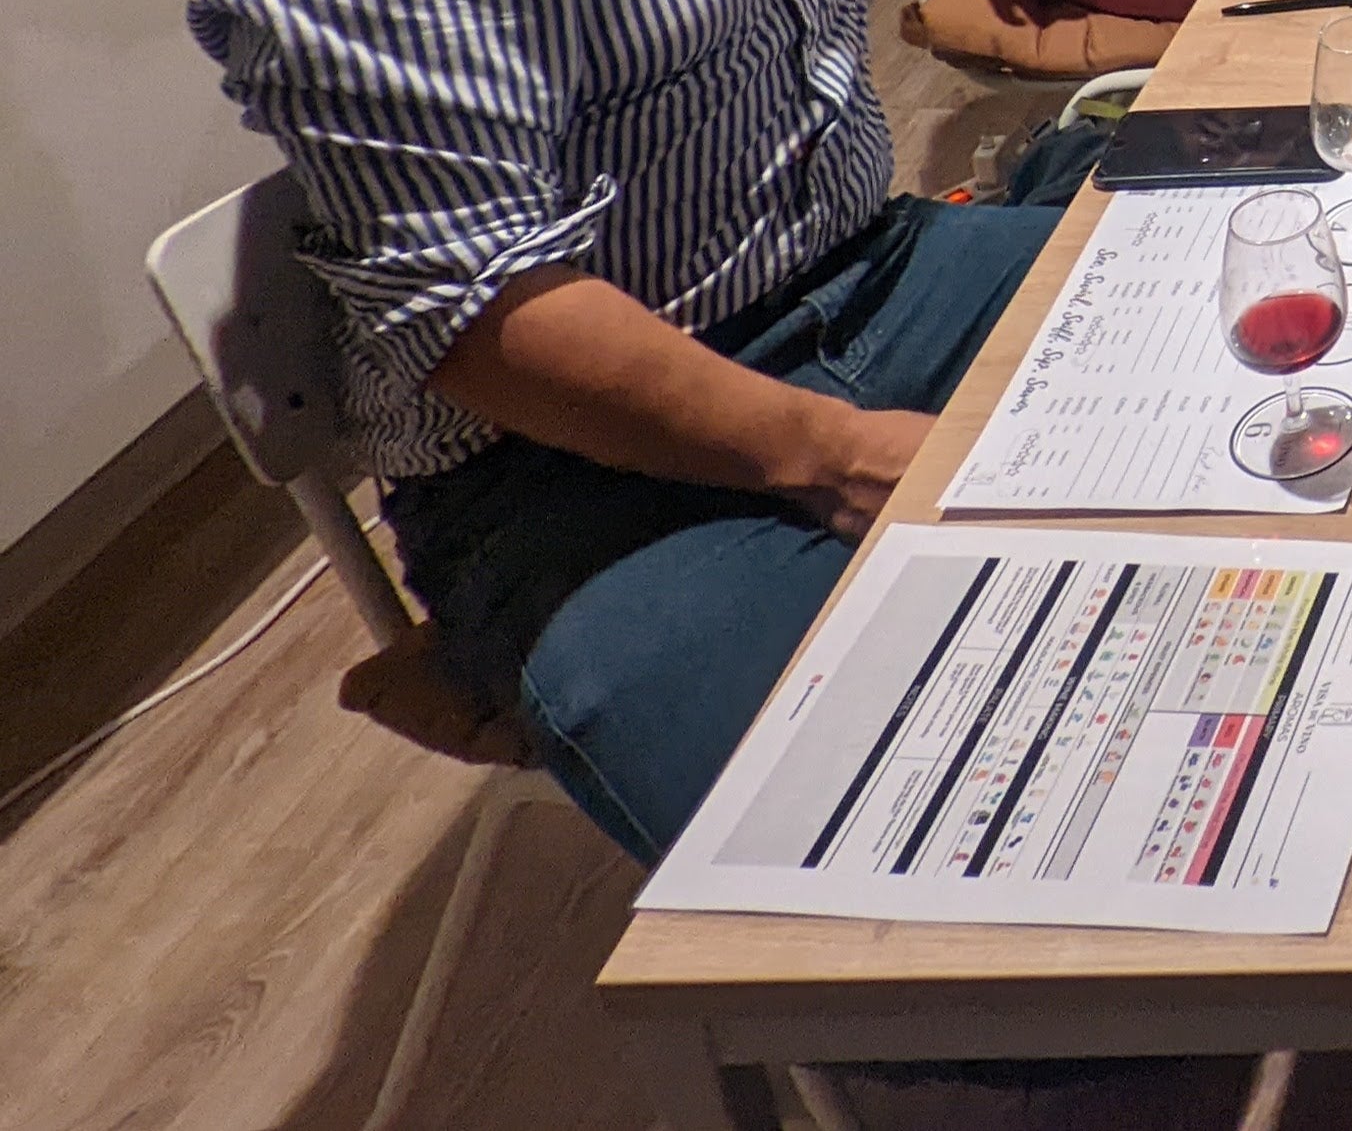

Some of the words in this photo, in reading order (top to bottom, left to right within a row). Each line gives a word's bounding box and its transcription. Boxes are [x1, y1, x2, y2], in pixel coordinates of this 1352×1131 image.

[1245, 423, 1272, 438] 6
[893, 684, 922, 717] NOTES
[1056, 676, 1077, 700] WINE
[1313, 682, 1331, 707] VISA
[1277, 692, 1304, 742] AROMAS
[1296, 724, 1315, 754] VINO
